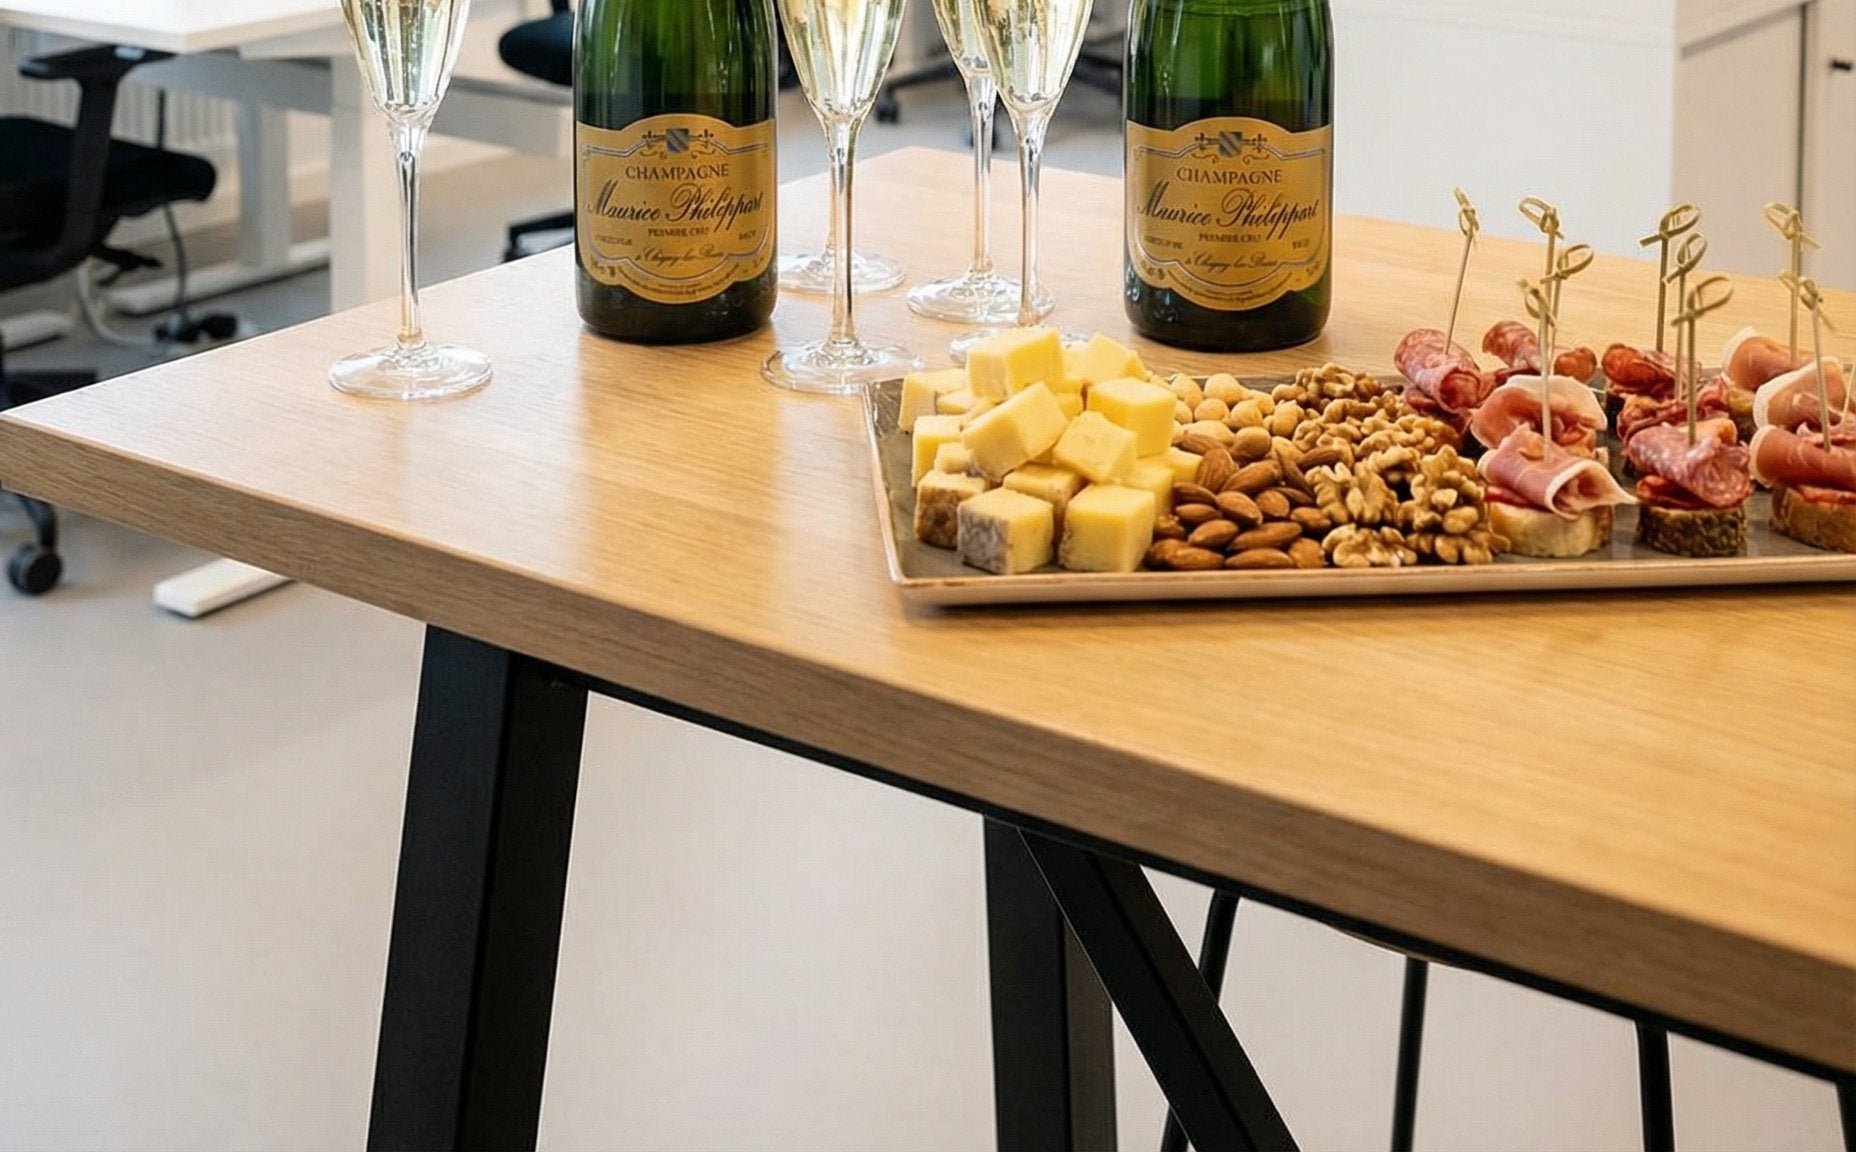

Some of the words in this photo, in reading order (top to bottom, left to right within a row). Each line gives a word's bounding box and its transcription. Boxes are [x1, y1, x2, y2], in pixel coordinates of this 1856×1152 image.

[625, 163, 729, 180] CHAMPAGNE
[1176, 166, 1283, 184] CHAMPAGNE
[587, 179, 661, 221] Maurice
[1138, 179, 1211, 225] Maurice
